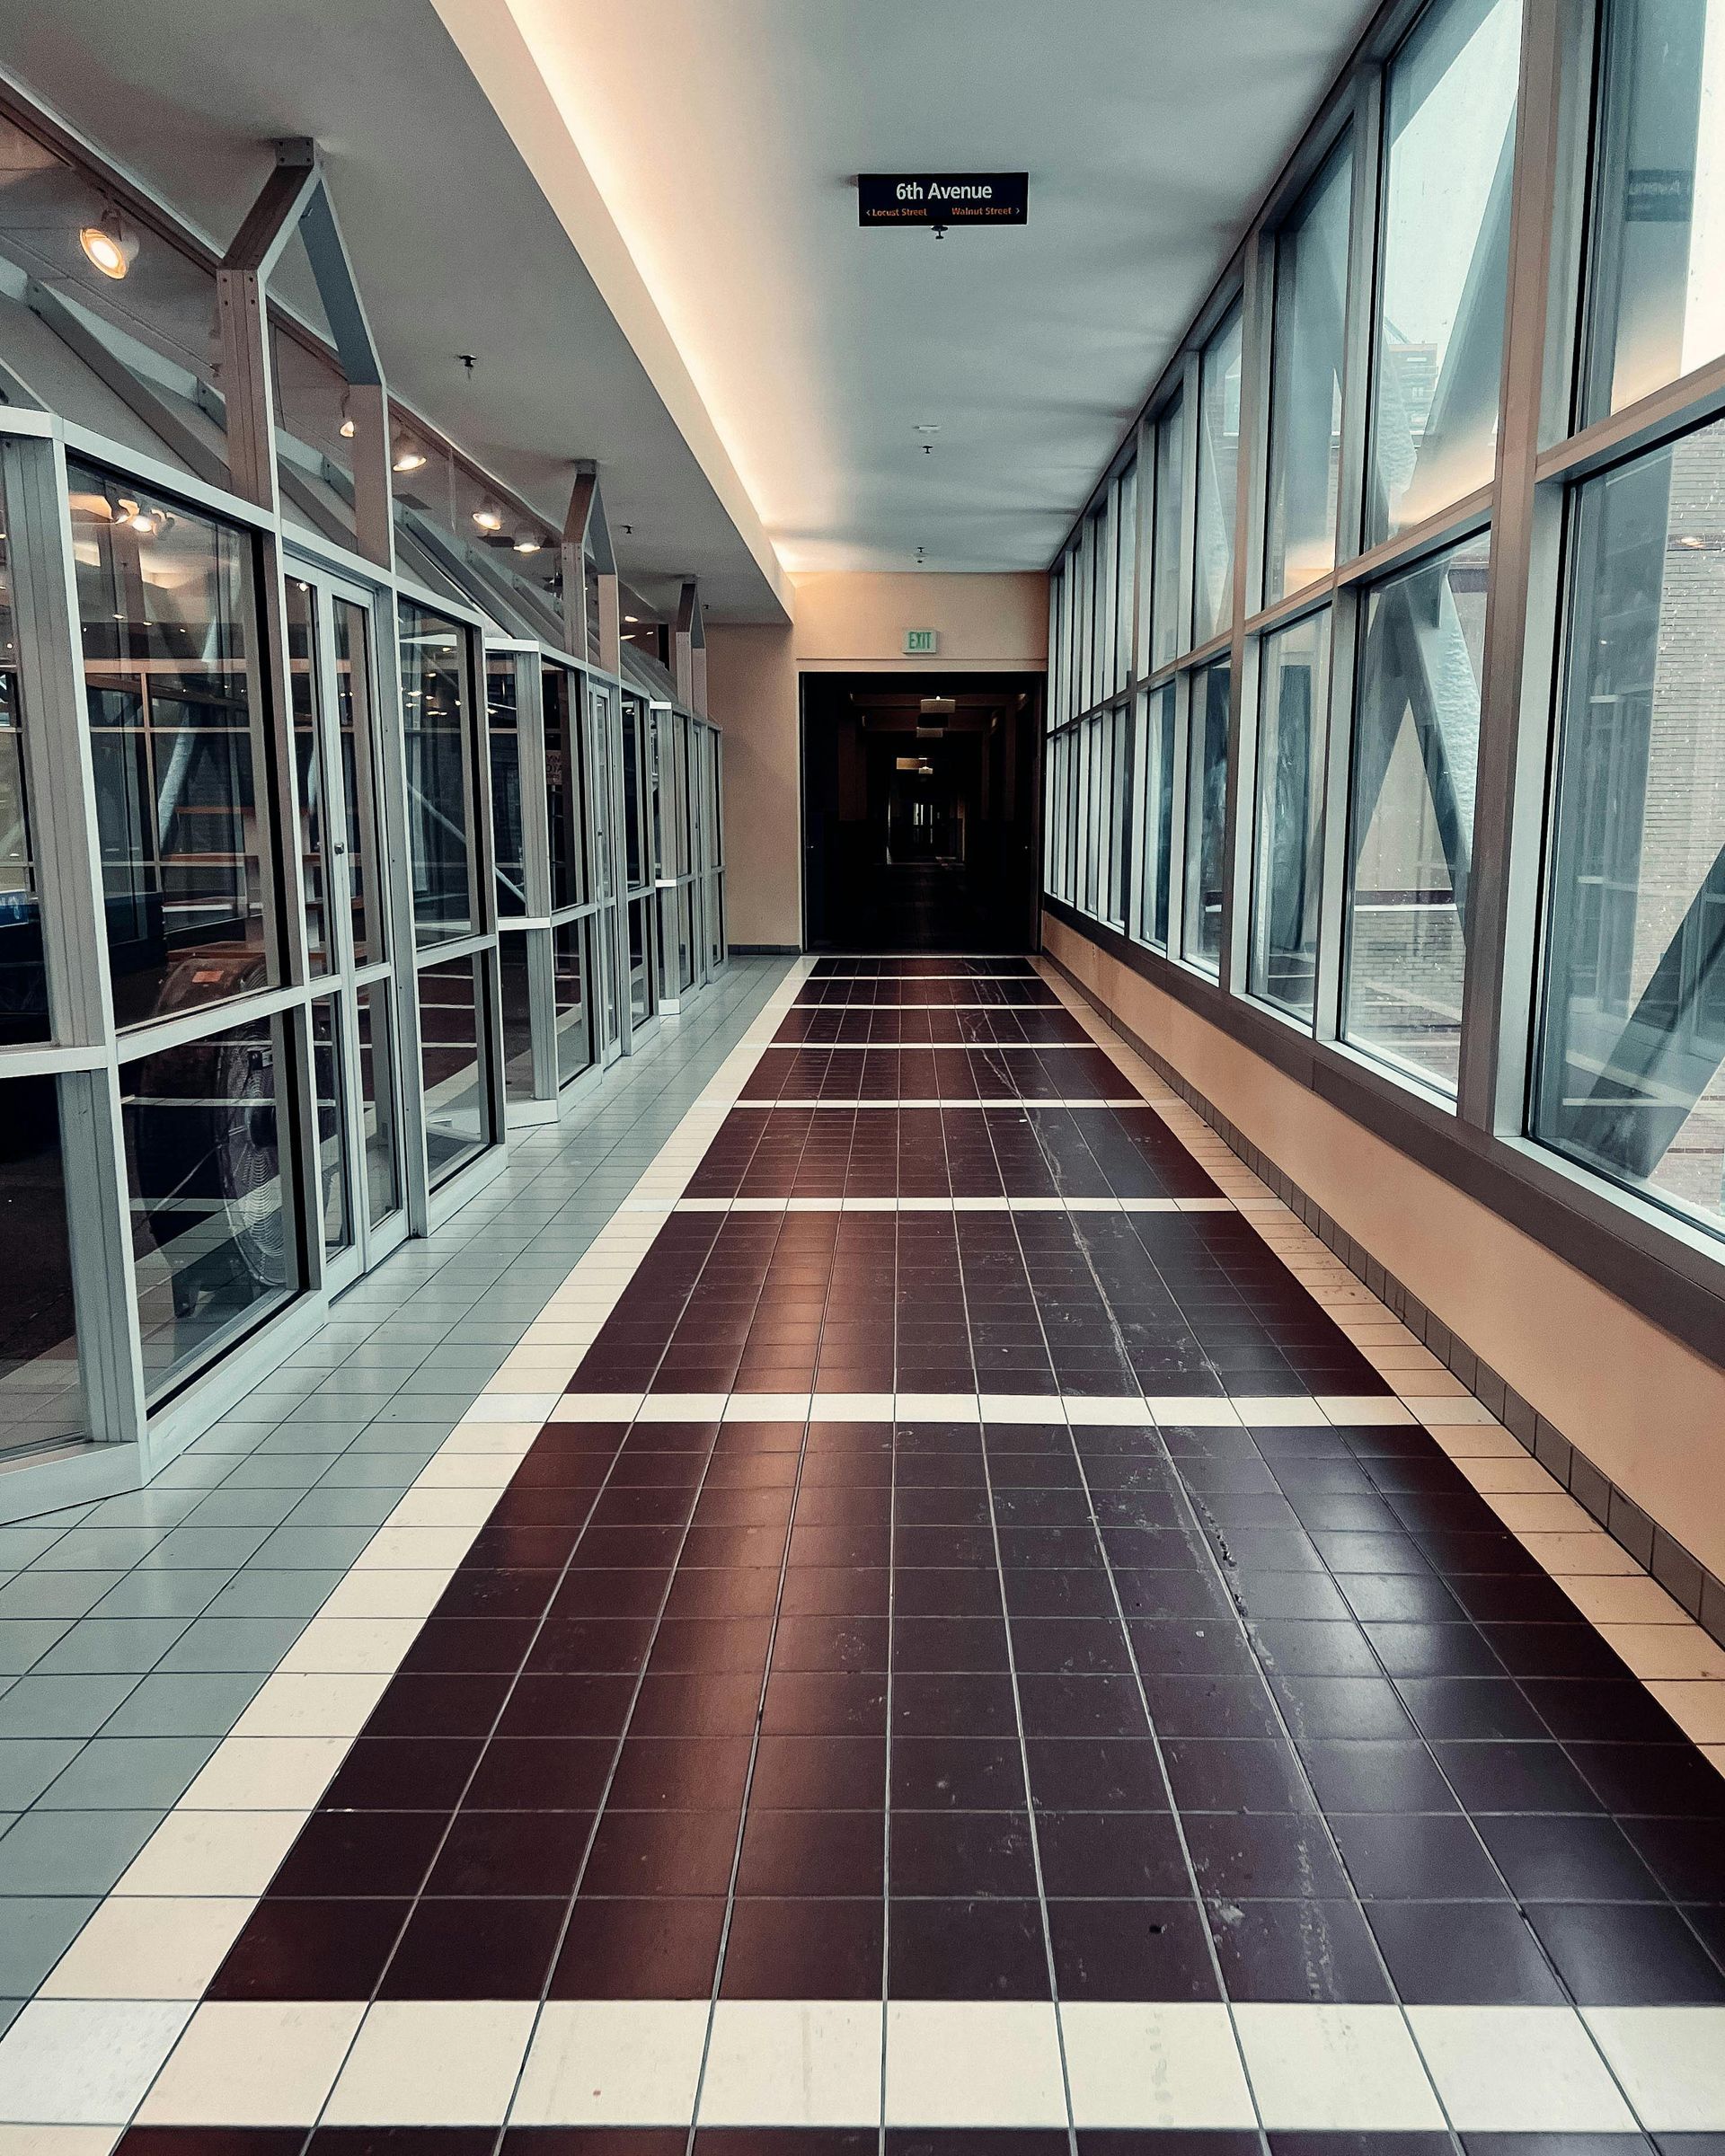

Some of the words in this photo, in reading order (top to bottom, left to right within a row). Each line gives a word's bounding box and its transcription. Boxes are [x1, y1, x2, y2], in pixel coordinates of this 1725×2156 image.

[897, 182, 924, 200] 6th
[927, 182, 993, 199] Avenue
[872, 208, 899, 216] Locust
[901, 208, 928, 216] Street
[951, 208, 983, 216] Walnut
[985, 207, 1012, 216] Street
[908, 632, 932, 649] EXIT
